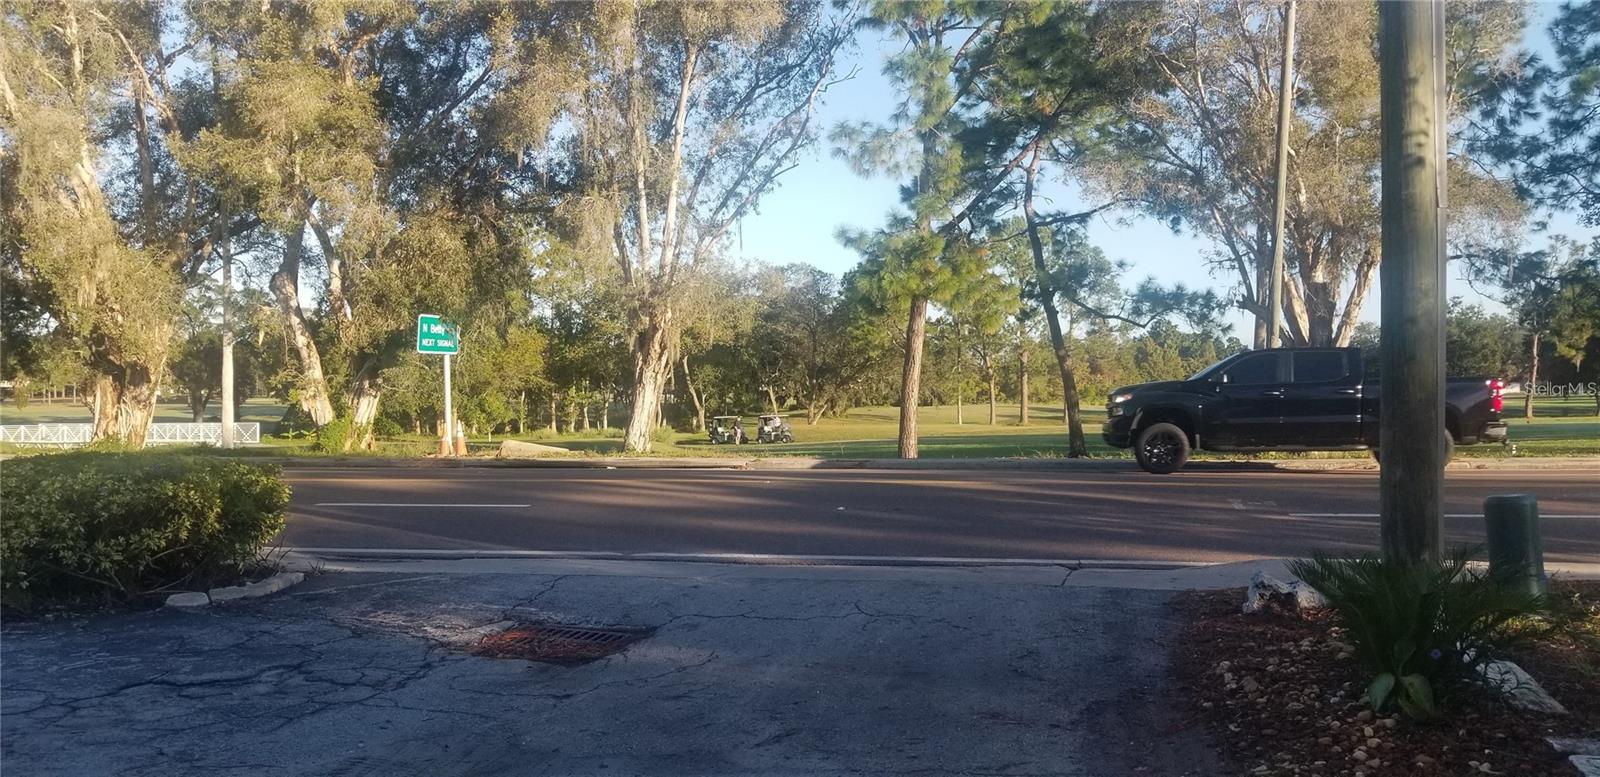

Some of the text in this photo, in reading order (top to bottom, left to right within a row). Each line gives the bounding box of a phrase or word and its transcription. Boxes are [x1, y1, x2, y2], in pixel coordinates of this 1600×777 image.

[422, 323, 428, 333] N
[421, 338, 455, 348] NEXT SIGNAL
